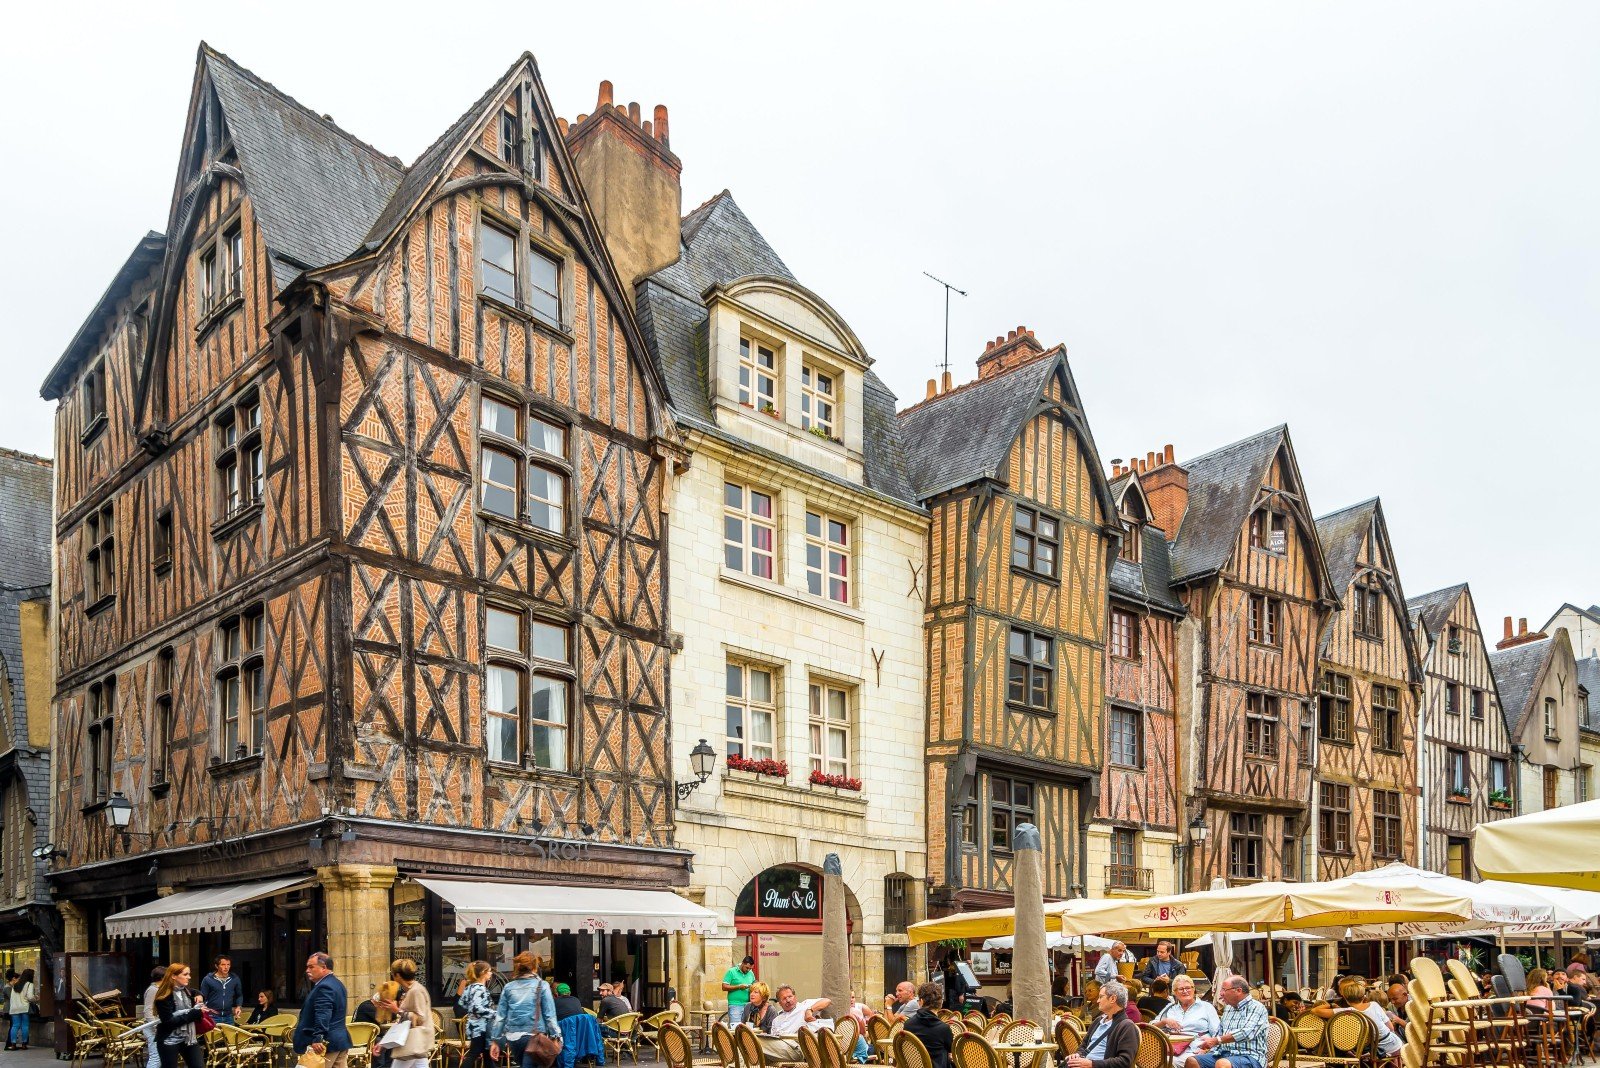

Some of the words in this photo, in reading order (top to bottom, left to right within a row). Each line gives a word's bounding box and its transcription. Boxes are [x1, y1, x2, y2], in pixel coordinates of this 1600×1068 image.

[791, 890, 805, 910] &
[805, 890, 817, 910] Co
[1385, 891, 1392, 904] 3
[1161, 908, 1168, 920] 3
[476, 918, 505, 926] BAR
